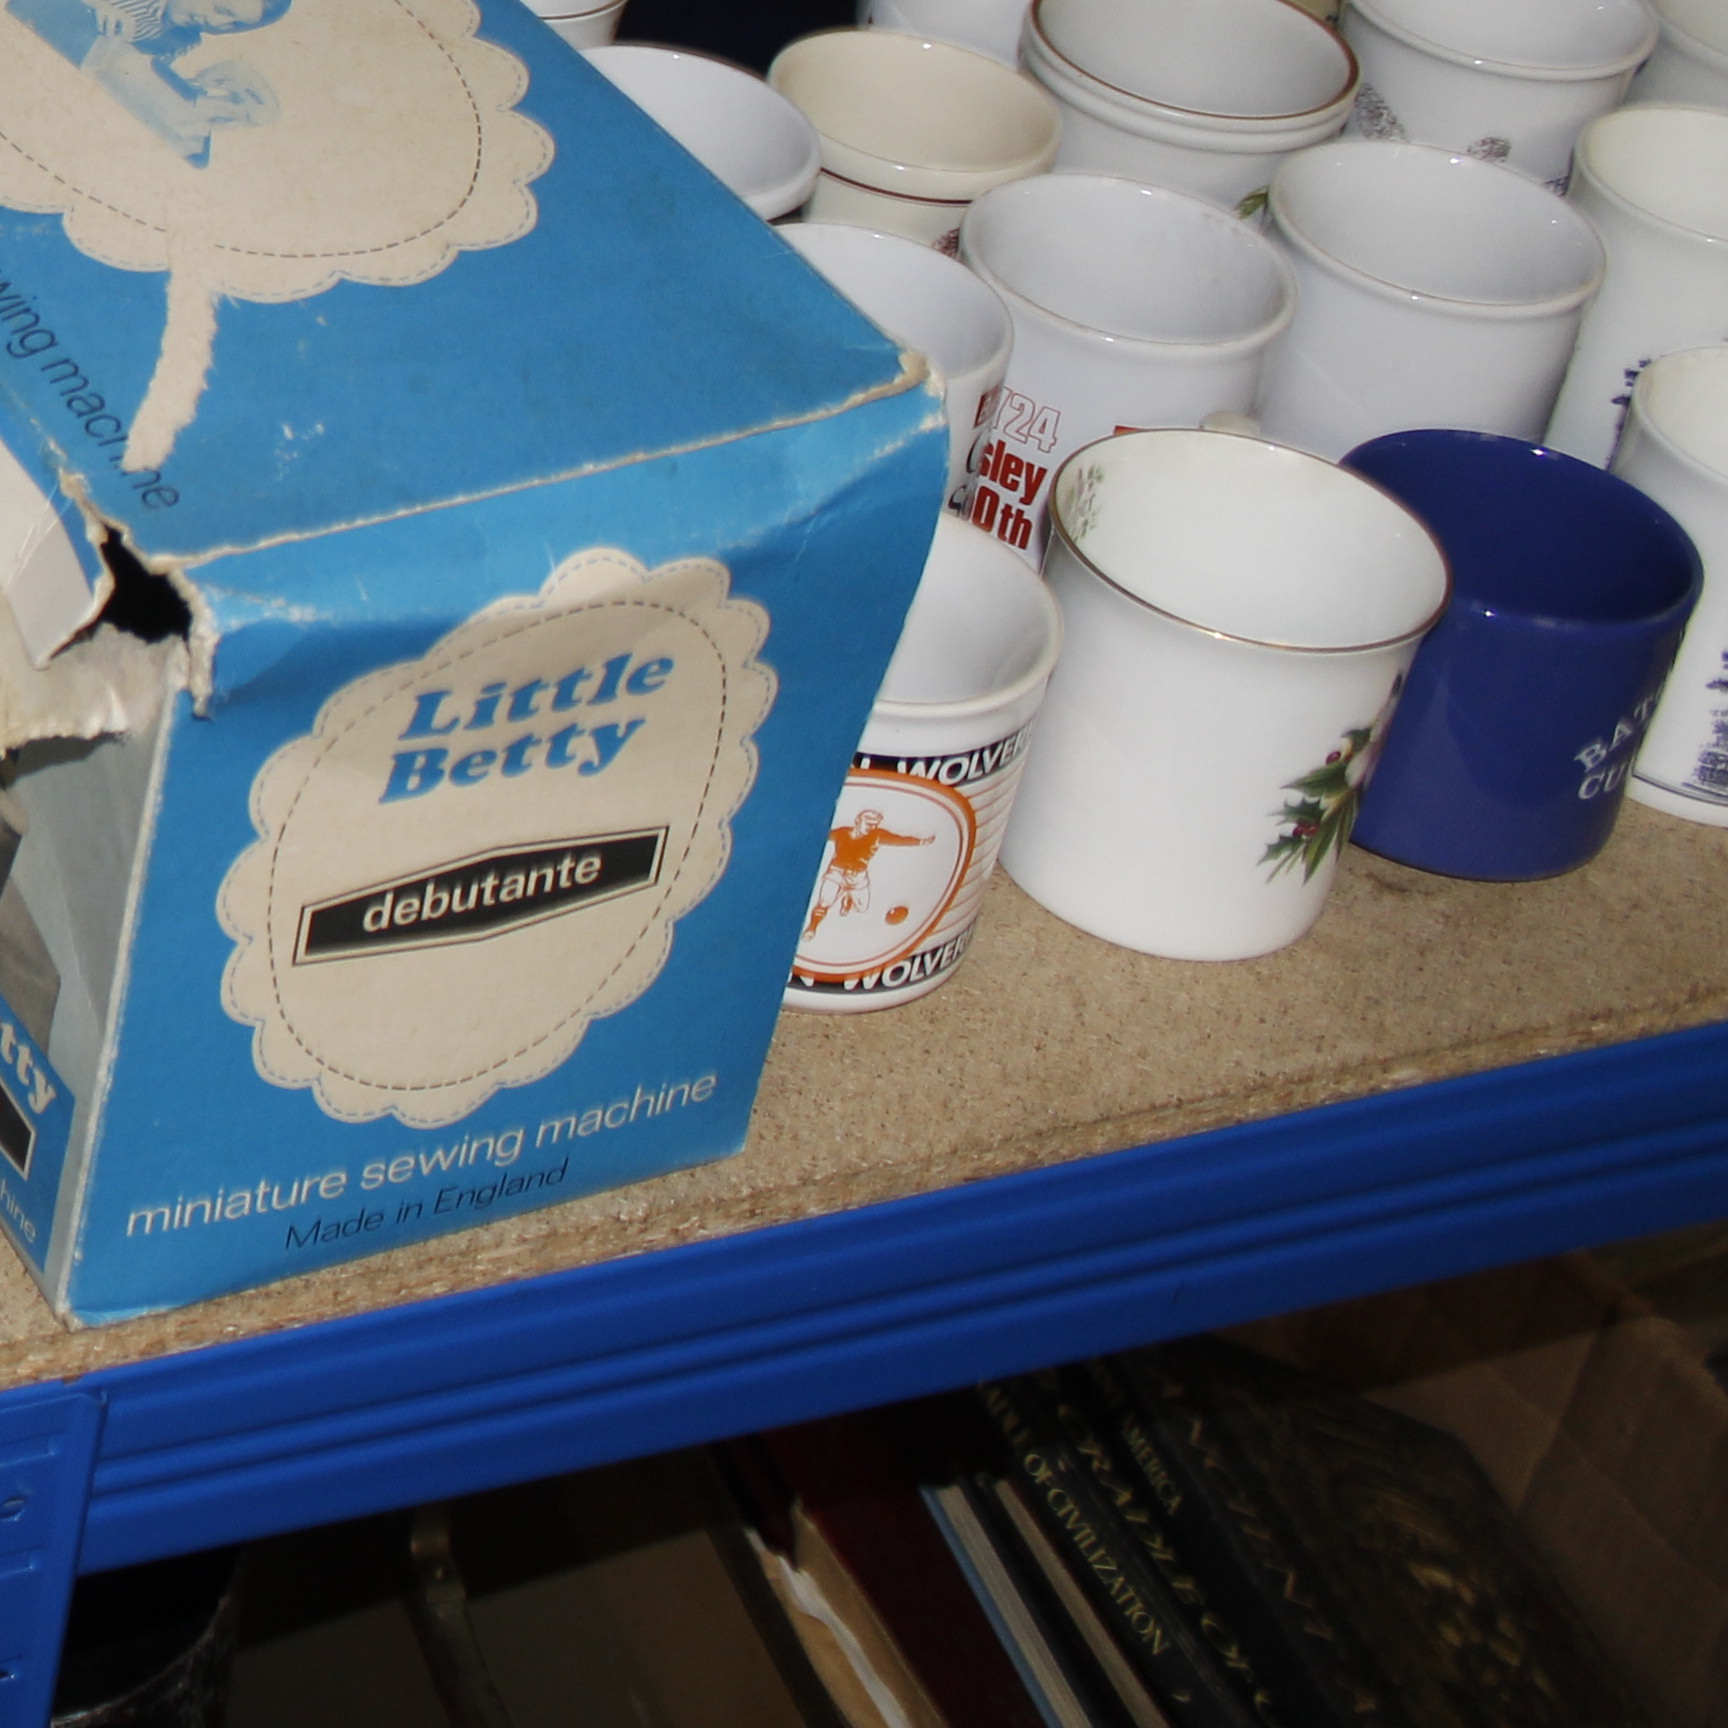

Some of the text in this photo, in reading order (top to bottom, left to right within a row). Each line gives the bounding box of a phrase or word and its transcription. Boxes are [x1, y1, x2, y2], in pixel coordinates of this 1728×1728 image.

[397, 653, 674, 741] Little
[378, 719, 646, 805] Betty
[362, 850, 602, 933] debutante
[125, 1073, 718, 1237] miniature sewing machine
[284, 1157, 570, 1251] Made in England
[1047, 1488, 1170, 1656] CIVILIZATION
